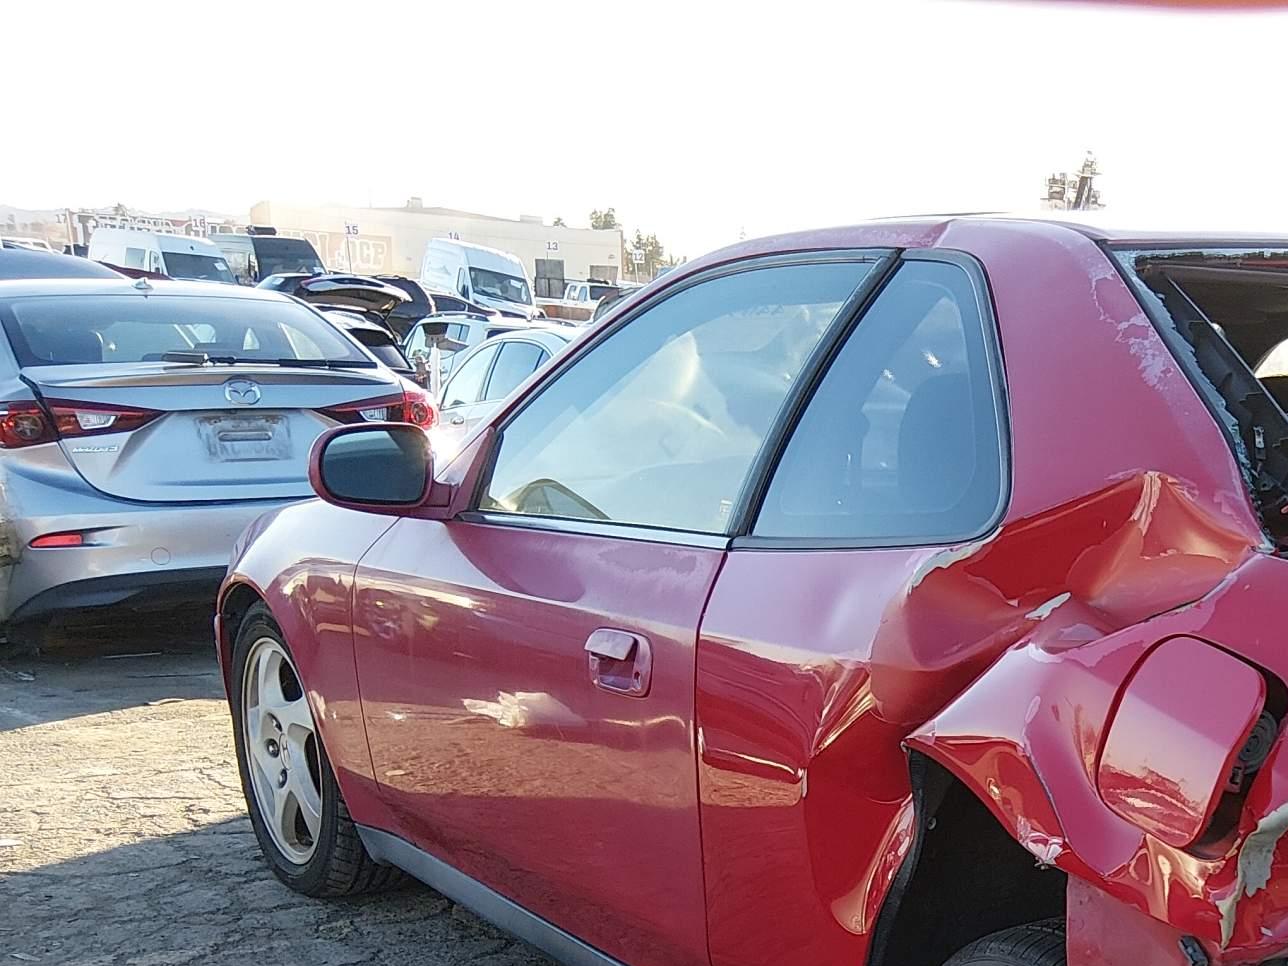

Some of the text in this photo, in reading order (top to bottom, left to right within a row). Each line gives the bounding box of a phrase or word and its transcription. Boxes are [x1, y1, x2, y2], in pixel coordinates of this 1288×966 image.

[193, 217, 206, 228] 16
[345, 225, 359, 235] 15
[546, 241, 559, 251] 13
[633, 252, 644, 262] 12
